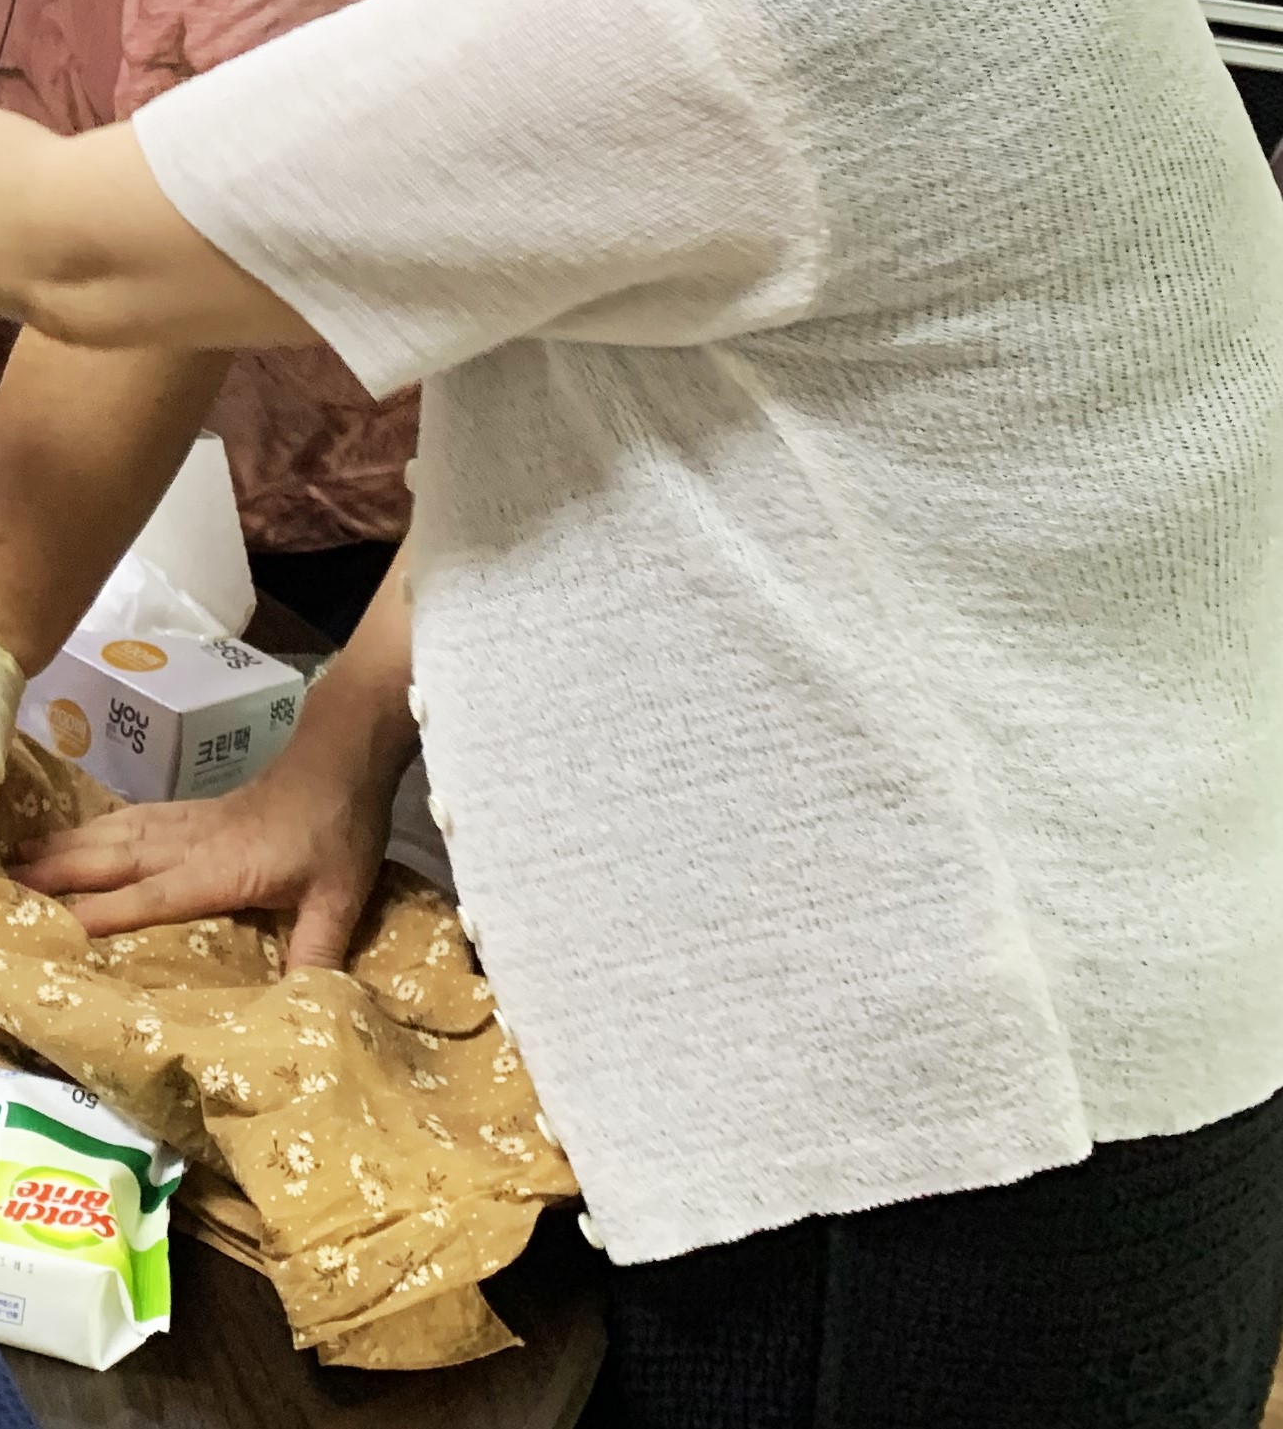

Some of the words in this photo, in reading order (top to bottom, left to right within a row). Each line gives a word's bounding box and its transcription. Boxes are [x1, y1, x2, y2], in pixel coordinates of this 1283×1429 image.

[108, 697, 150, 731] you
[194, 724, 252, 767] 크린팩
[15, 1180, 111, 1212] Brite
